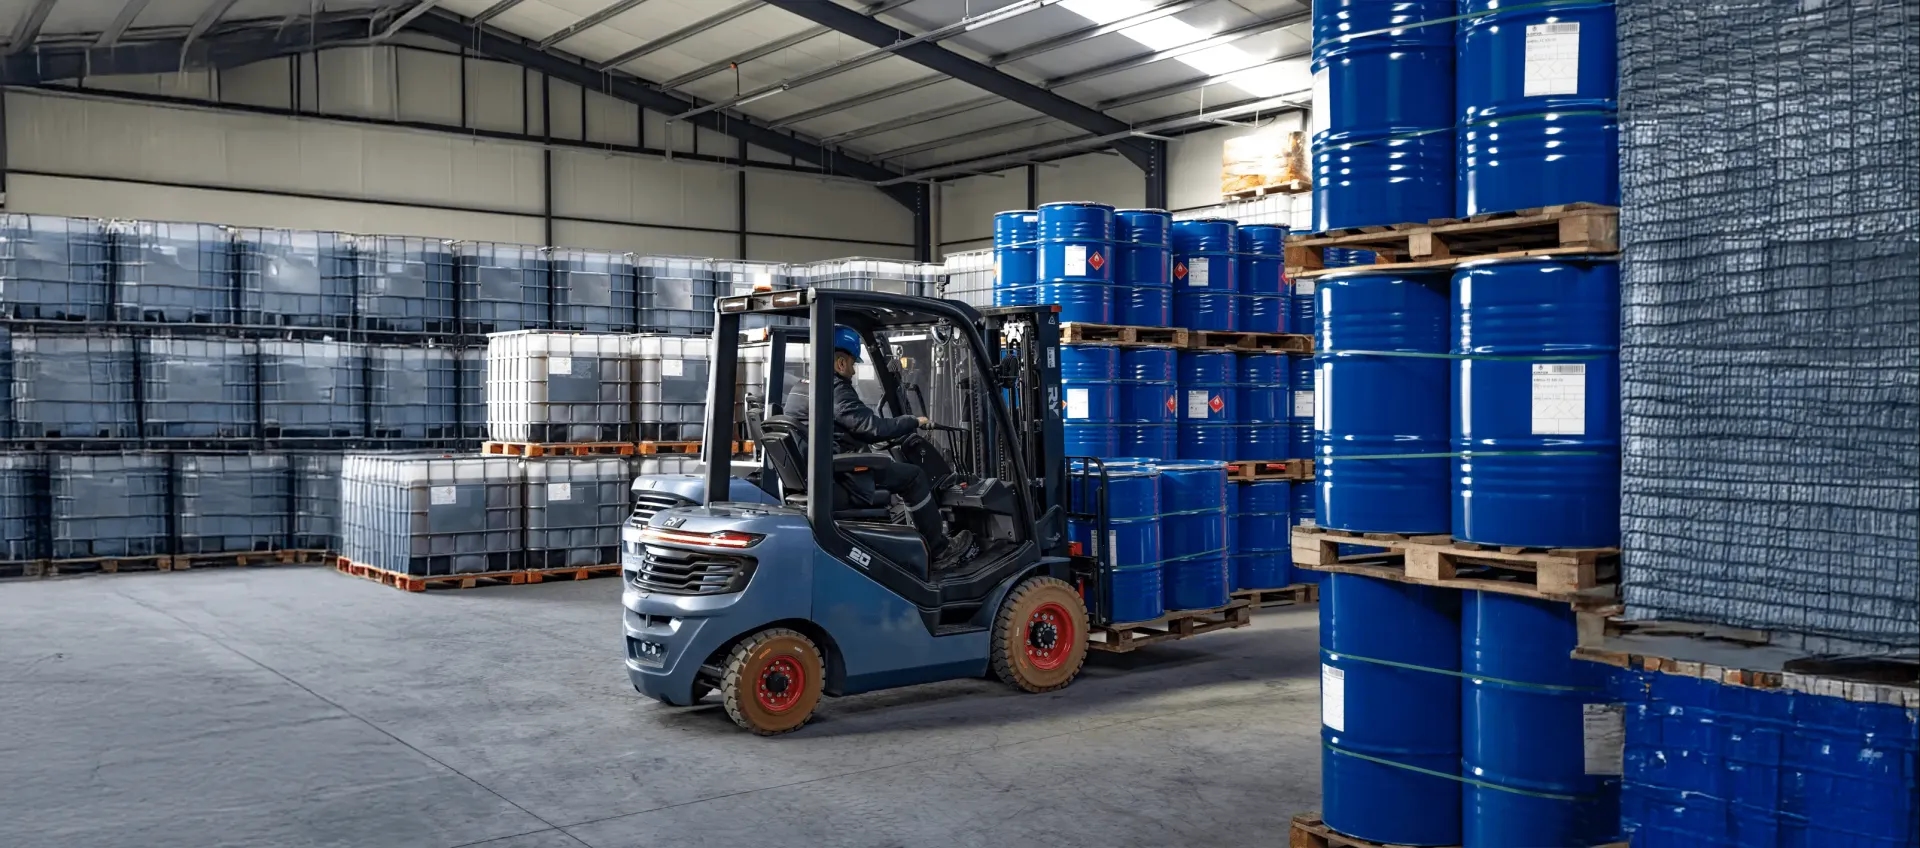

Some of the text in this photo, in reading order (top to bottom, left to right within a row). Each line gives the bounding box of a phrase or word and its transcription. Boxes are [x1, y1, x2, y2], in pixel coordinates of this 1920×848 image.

[1047, 386, 1060, 417] RY
[664, 517, 682, 527] RY
[849, 546, 871, 567] 20
